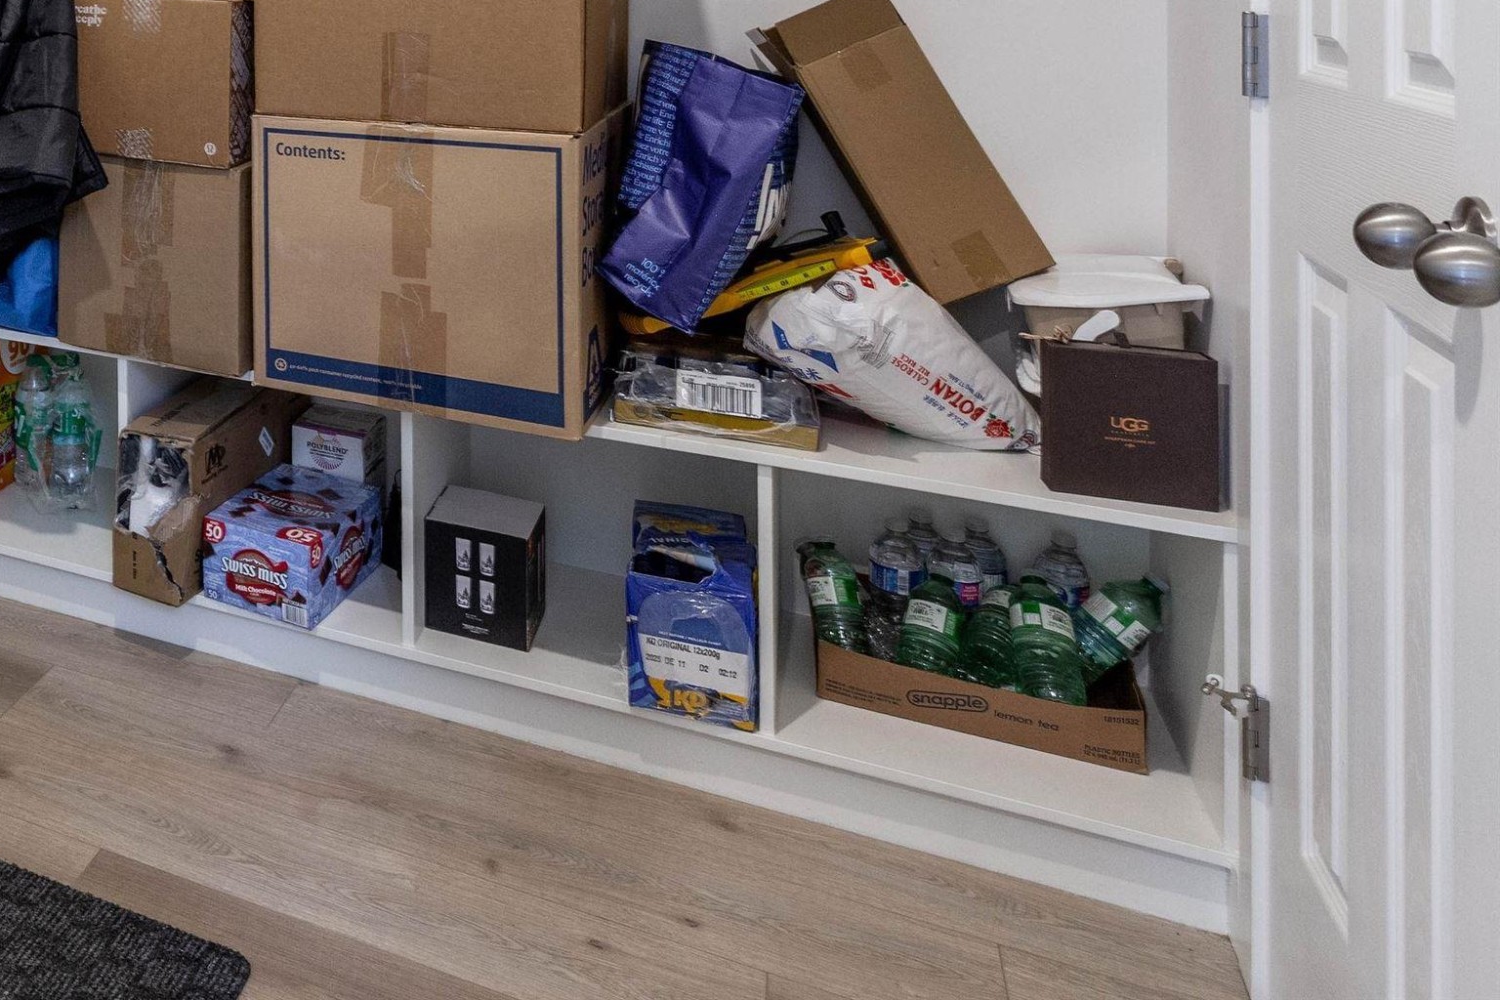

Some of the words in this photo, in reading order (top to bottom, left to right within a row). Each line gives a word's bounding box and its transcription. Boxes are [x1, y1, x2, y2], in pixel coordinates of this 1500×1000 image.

[75, 4, 107, 15] reathe
[76, 15, 102, 27] eeply
[276, 142, 346, 162] Contents:
[641, 257, 659, 273] 100
[901, 353, 917, 368] RICE
[891, 357, 930, 386] CALROSE
[917, 364, 931, 377] RIZ
[929, 378, 986, 421] BOTAN
[1111, 416, 1150, 432] UGG
[307, 441, 348, 454] POLYBLEND
[289, 505, 335, 519] SWISS
[205, 523, 223, 540] 50
[285, 528, 318, 542] 50
[221, 556, 257, 577] SWISS
[208, 590, 218, 599] 50
[235, 583, 248, 593] Milk
[247, 585, 276, 598] Chocolate
[657, 639, 691, 654] ORIGINAL
[693, 644, 721, 660] 12x200g
[665, 655, 674, 666] DE
[678, 658, 686, 668] 11
[912, 693, 985, 712] snapple
[994, 709, 1033, 726] lemon
[1037, 719, 1059, 732] tea
